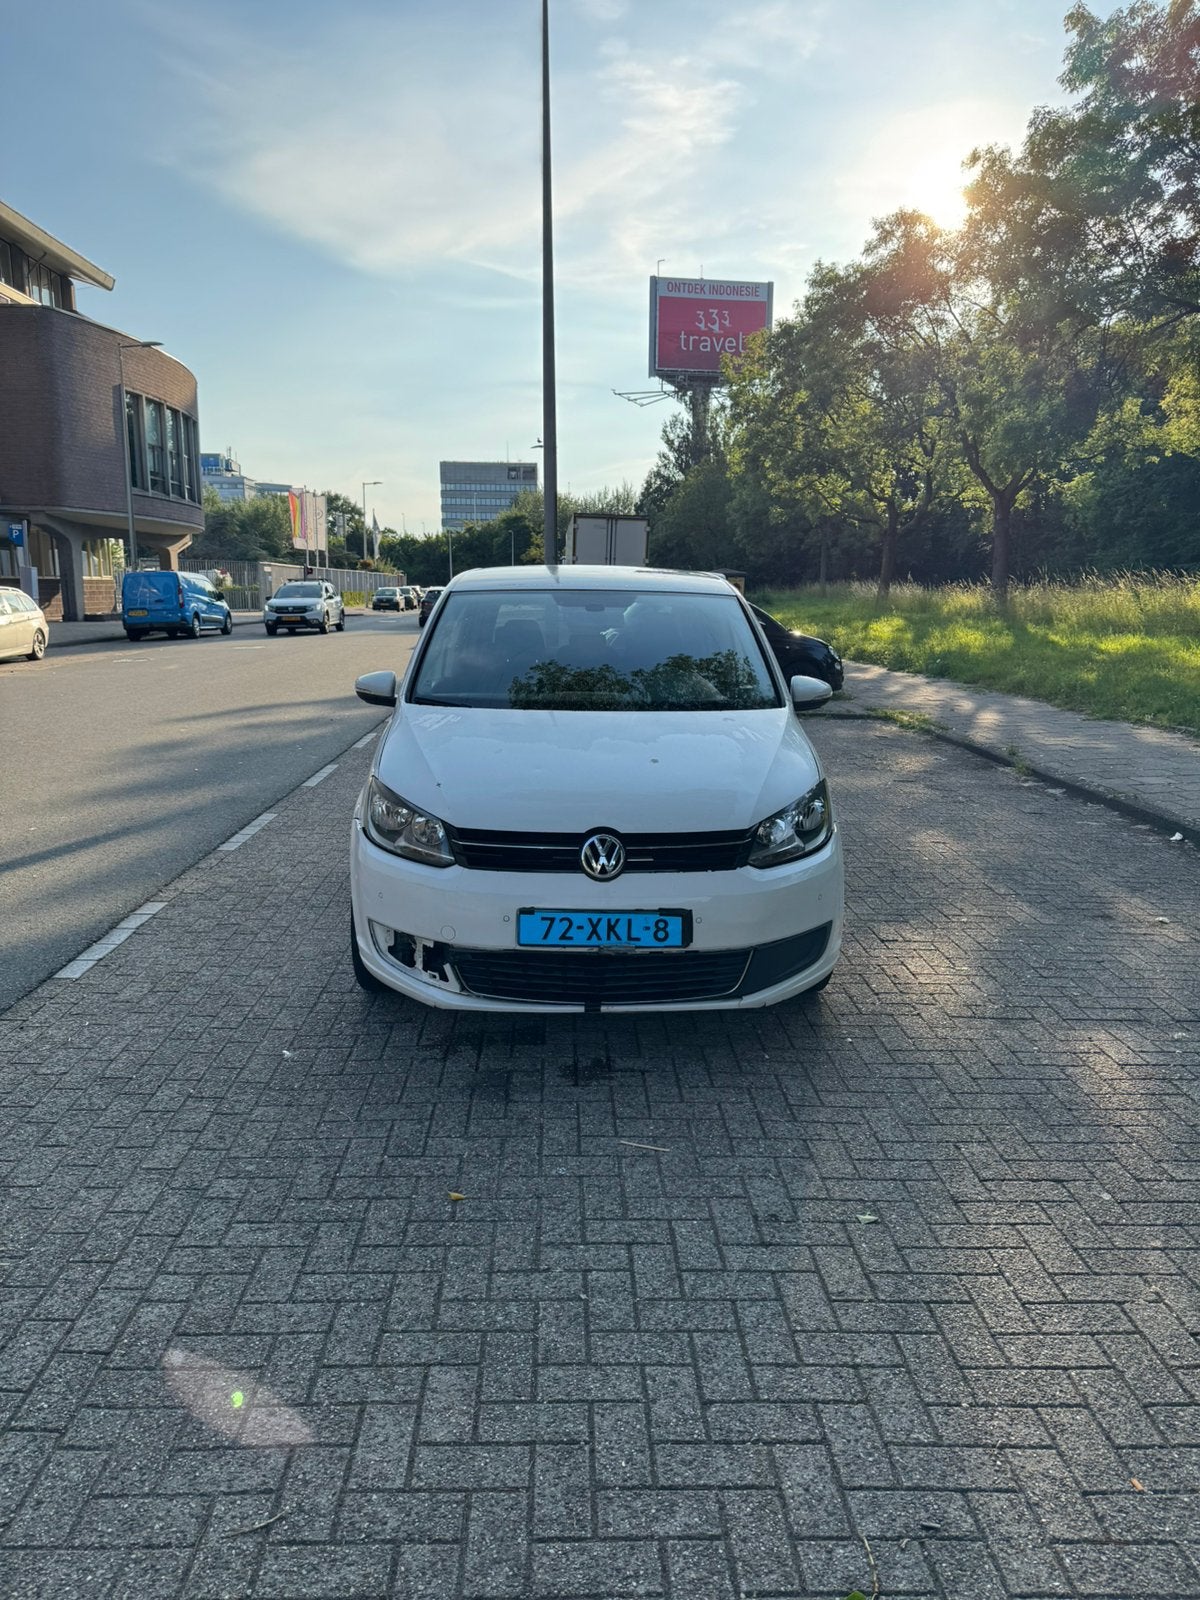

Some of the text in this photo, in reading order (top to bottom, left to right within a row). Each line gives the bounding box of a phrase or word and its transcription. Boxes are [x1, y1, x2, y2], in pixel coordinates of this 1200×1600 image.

[667, 281, 706, 295] ONTDEK
[680, 331, 744, 353] travel
[12, 529, 20, 539] P
[540, 916, 669, 942] 72-XKL-8
